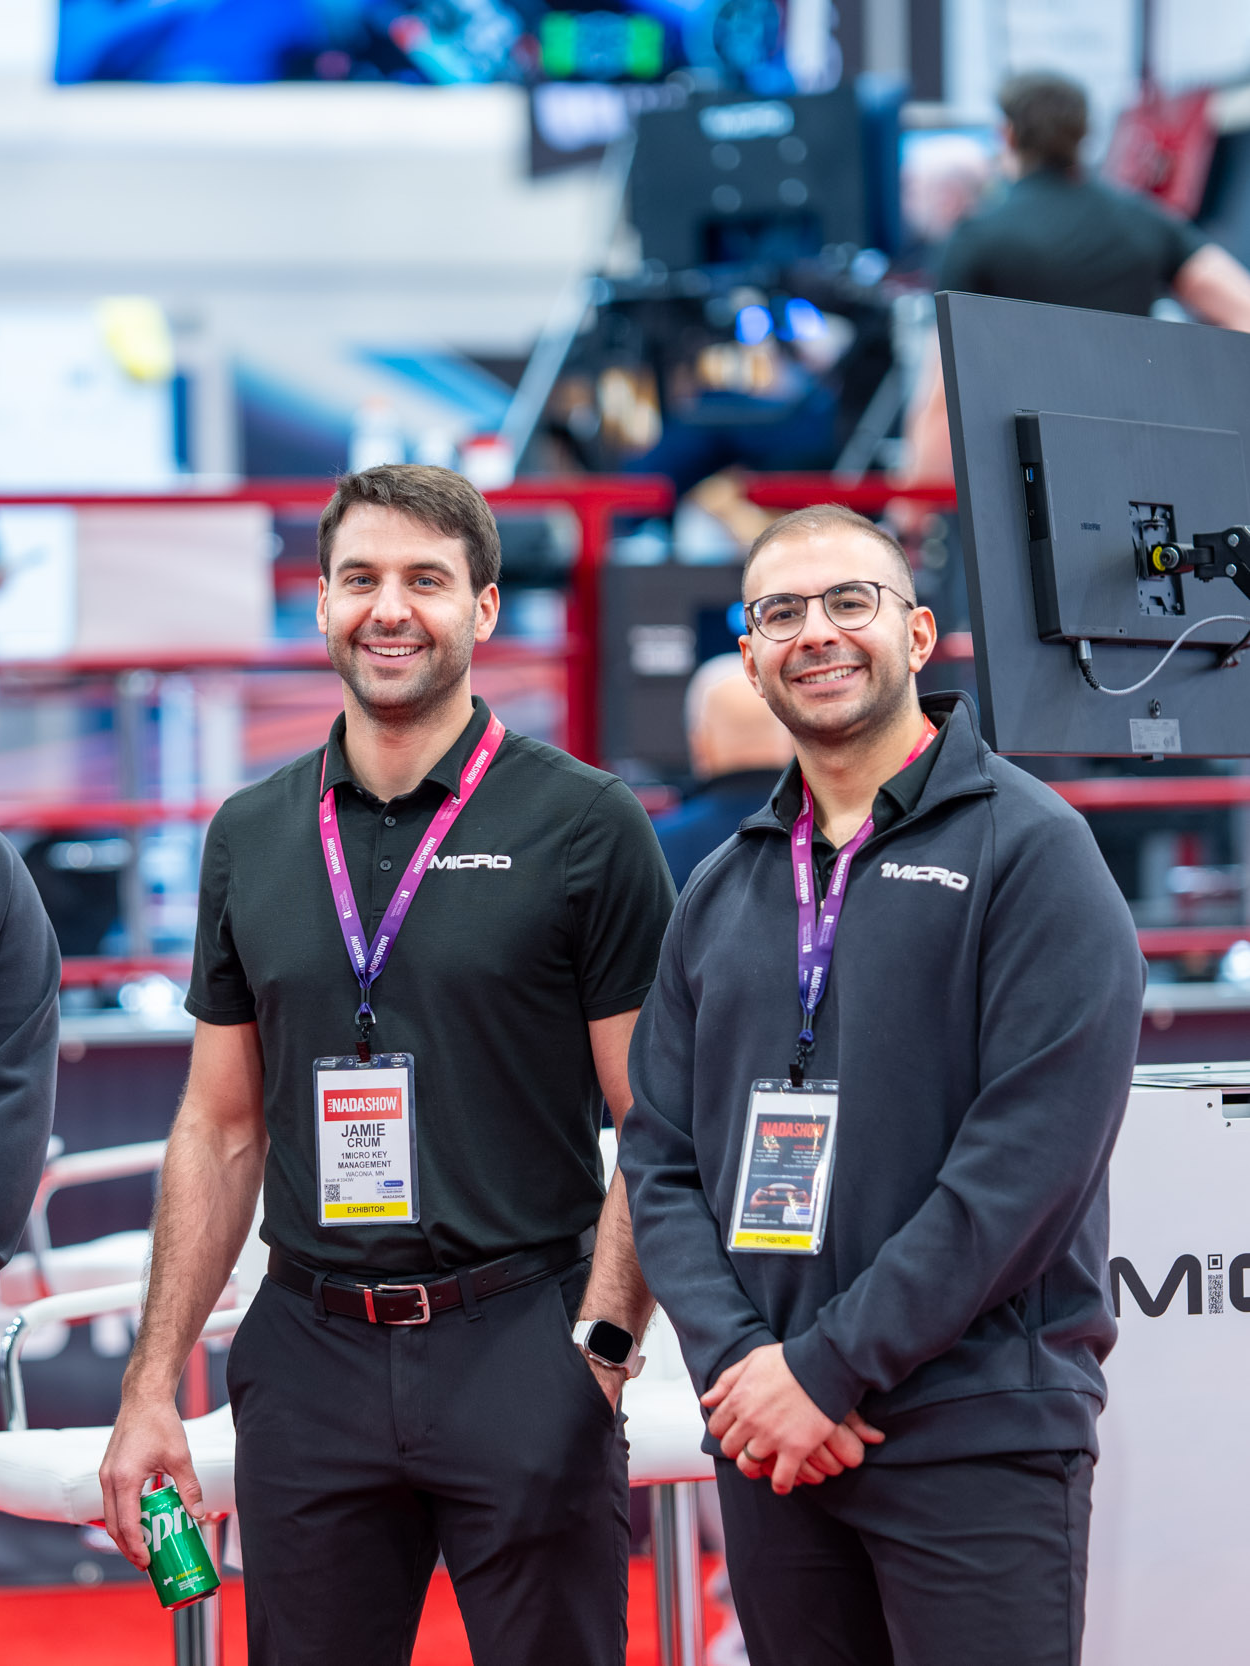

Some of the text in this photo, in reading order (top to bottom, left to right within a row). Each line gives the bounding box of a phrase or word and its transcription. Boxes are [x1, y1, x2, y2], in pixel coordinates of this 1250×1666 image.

[465, 749, 489, 785] NADASHOW
[327, 837, 341, 875] NADASHOW
[412, 837, 437, 874] NADASHOW
[427, 854, 512, 870] MICRO
[798, 863, 809, 904] NADASHOW
[831, 854, 850, 896] NADASHOW
[880, 862, 969, 891] 1MICRO
[807, 966, 824, 1009] NADASHOW
[332, 1096, 397, 1113] NADASHOW
[341, 1123, 386, 1137] JAMIE
[762, 1121, 825, 1139] NADASHOW
[347, 1137, 381, 1148] CRUM
[338, 1160, 392, 1169] MANAGEMENT
[341, 1151, 387, 1160] 1MICRO KEY
[347, 1205, 385, 1214] EXHIBITOR
